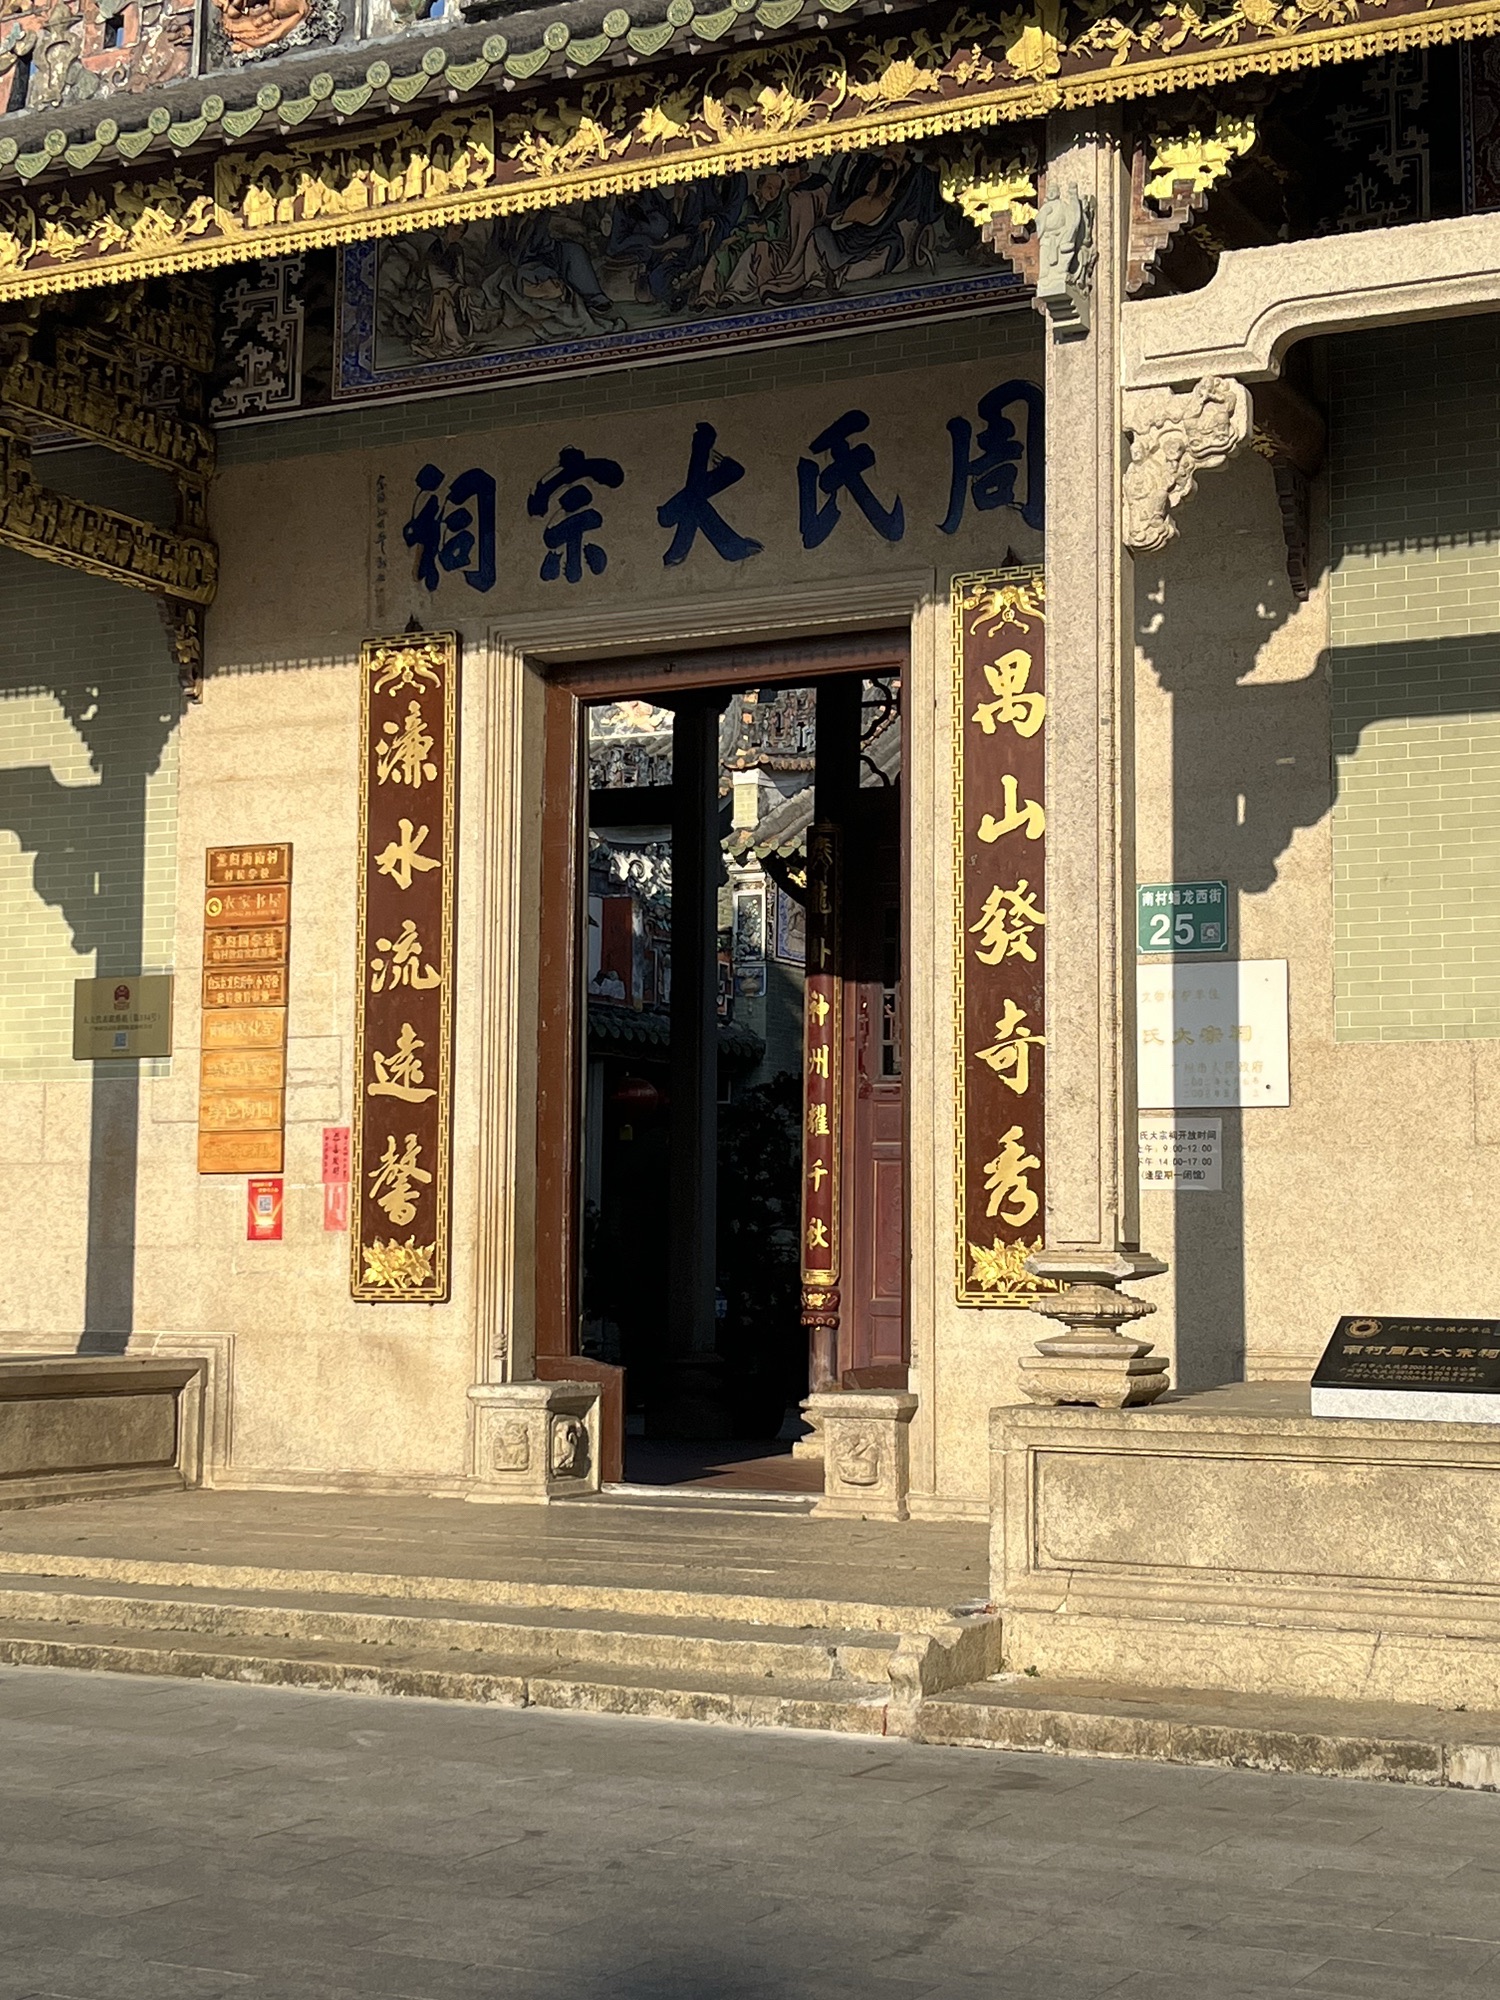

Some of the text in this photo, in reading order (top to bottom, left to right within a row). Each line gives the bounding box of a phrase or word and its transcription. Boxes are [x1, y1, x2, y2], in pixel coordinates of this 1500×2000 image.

[1142, 888, 1222, 907] 南村蟠龙西街
[969, 650, 1046, 1228] 禺山發奇秀
[1149, 913, 1195, 945] 25
[367, 700, 441, 1226] 濂水流遠馨
[1342, 1344, 1500, 1359] 南村周氏大宗祠
